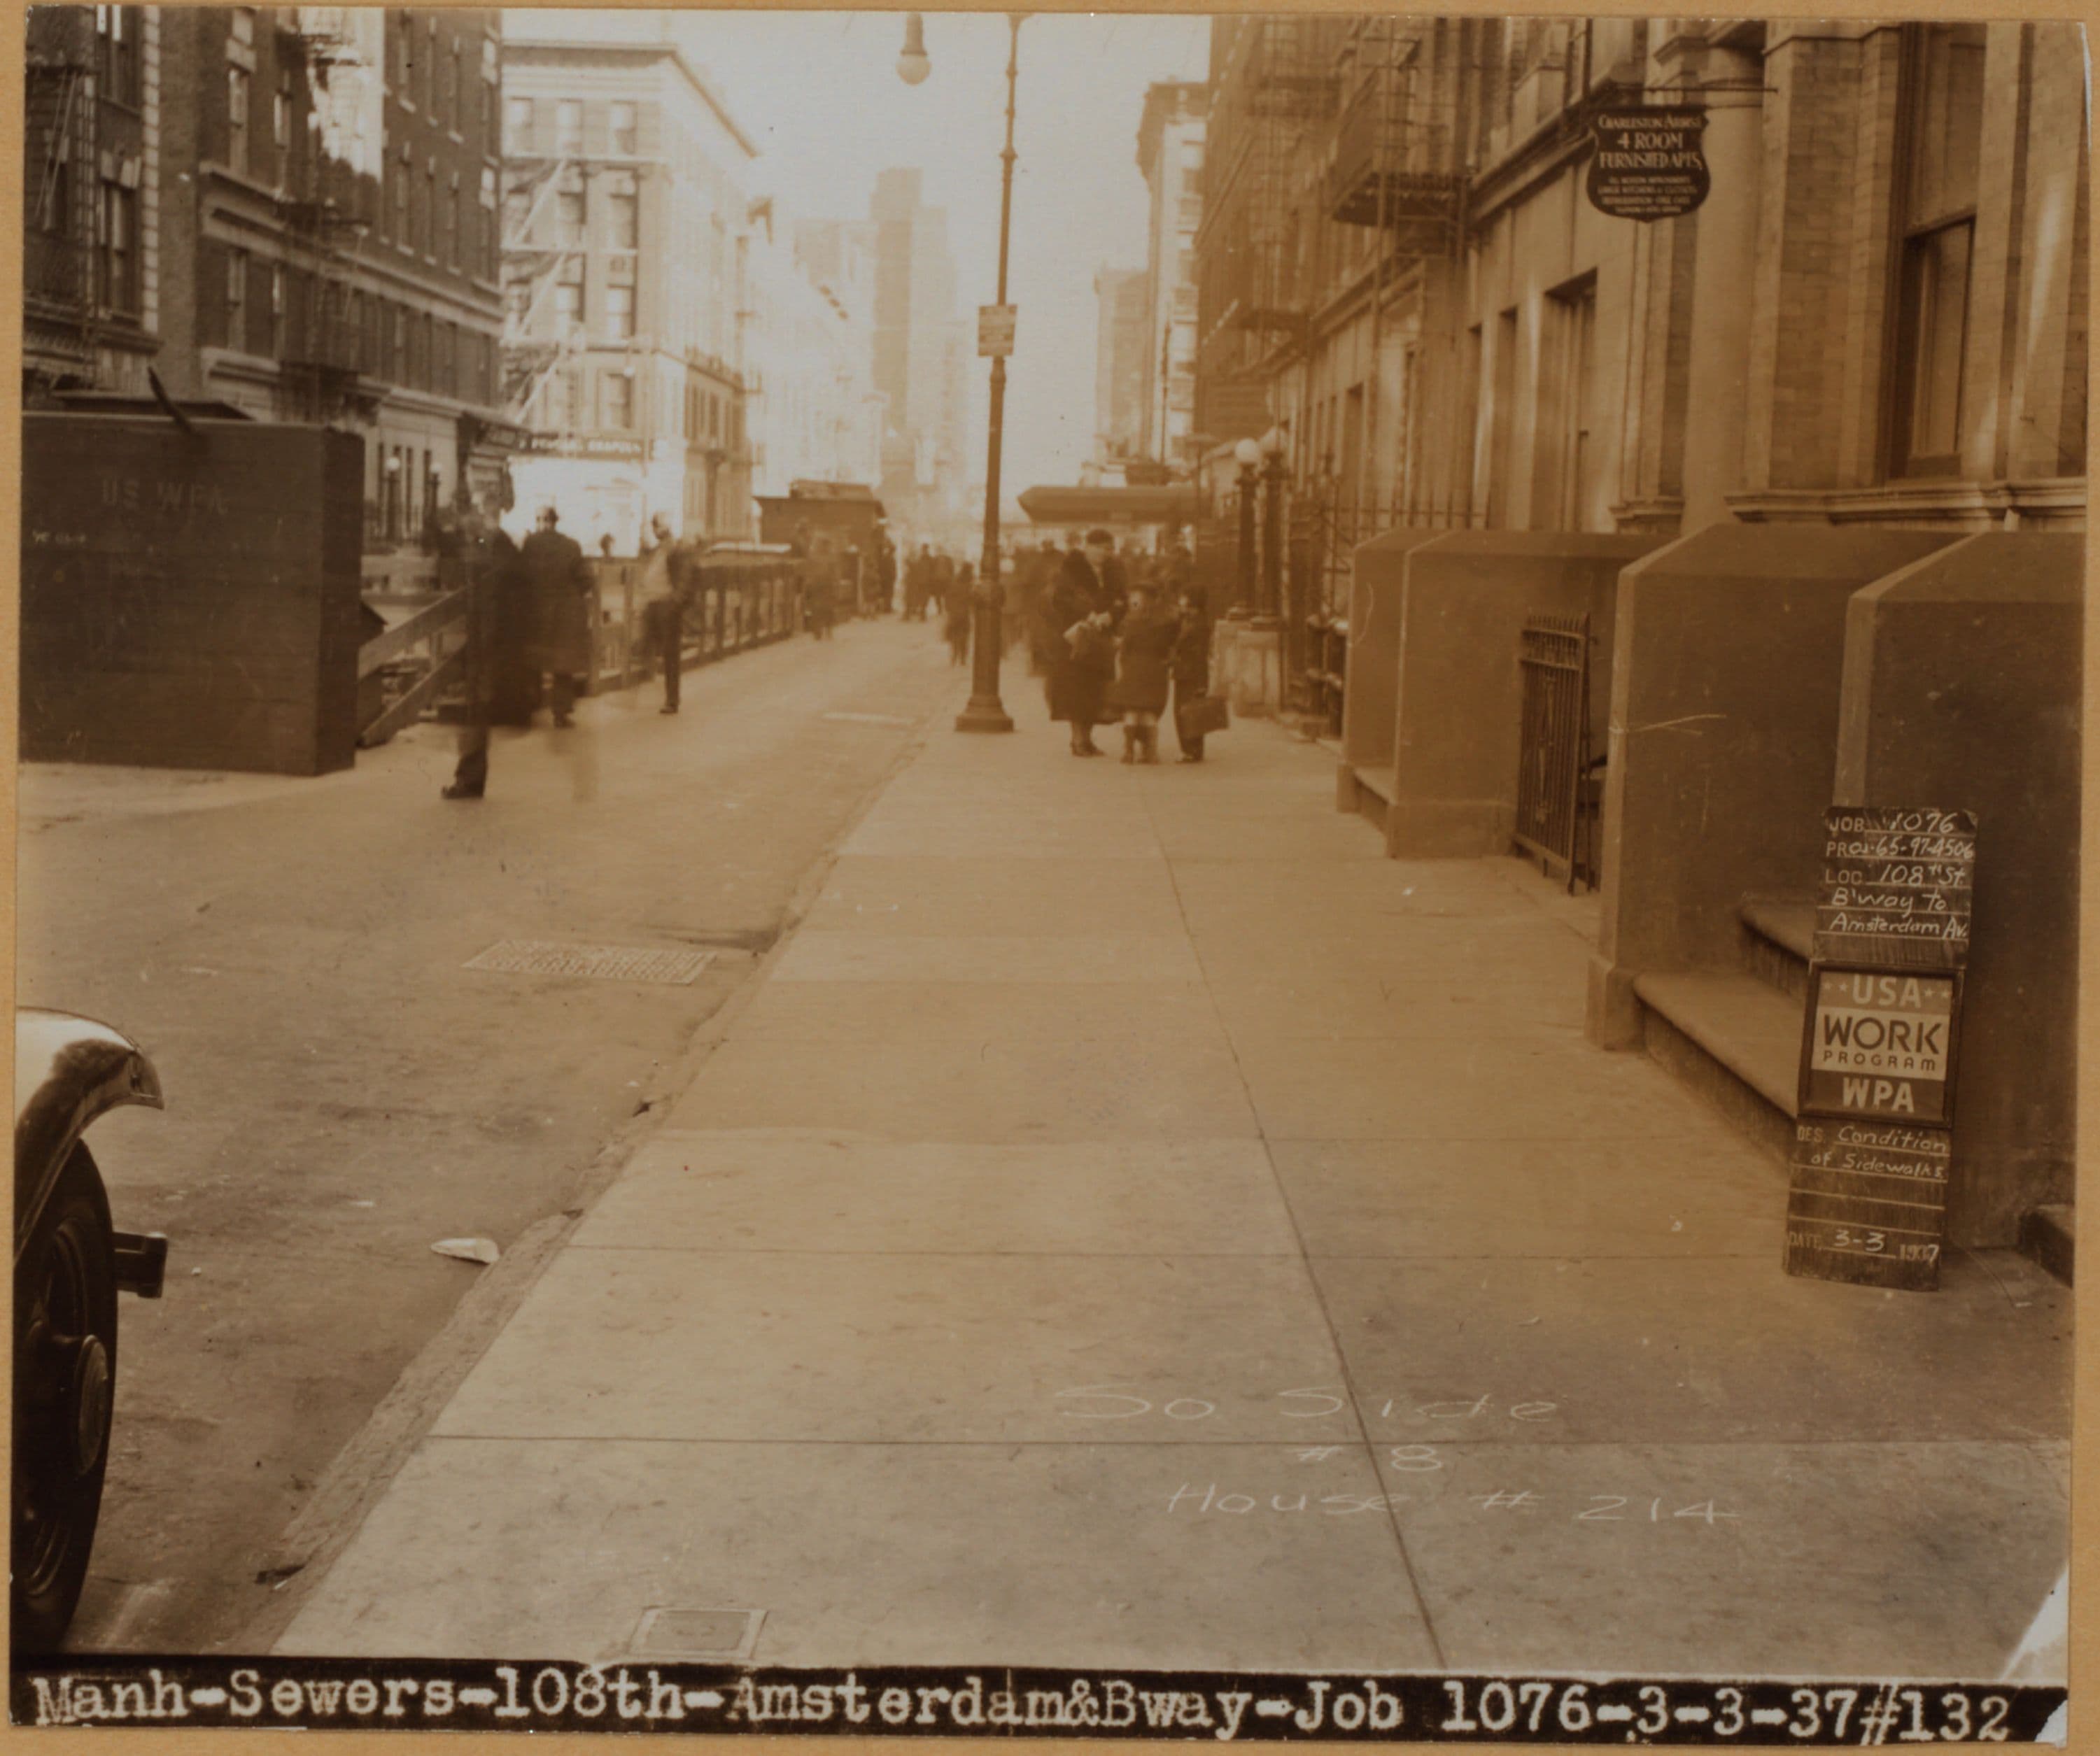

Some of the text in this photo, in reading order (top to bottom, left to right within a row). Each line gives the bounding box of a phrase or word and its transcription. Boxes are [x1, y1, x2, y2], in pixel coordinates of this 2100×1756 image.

[1617, 132, 1684, 150] 4 ROOM
[1598, 151, 1669, 169] FURNISHED
[1829, 816, 1865, 833] JOB
[1829, 912, 1940, 935] Amsterdam
[1852, 973, 1922, 1008] USA
[1823, 1014, 1943, 1055] WORK
[1822, 1050, 1936, 1071] PROGRAM
[1842, 1075, 1915, 1114] WPA
[1837, 1125, 1947, 1153] Condition
[1810, 1153, 1945, 1180] of Sidewalks
[1390, 1444, 1442, 1472] 8
[1169, 1482, 1409, 1514] House
[1578, 1495, 1740, 1525] 214
